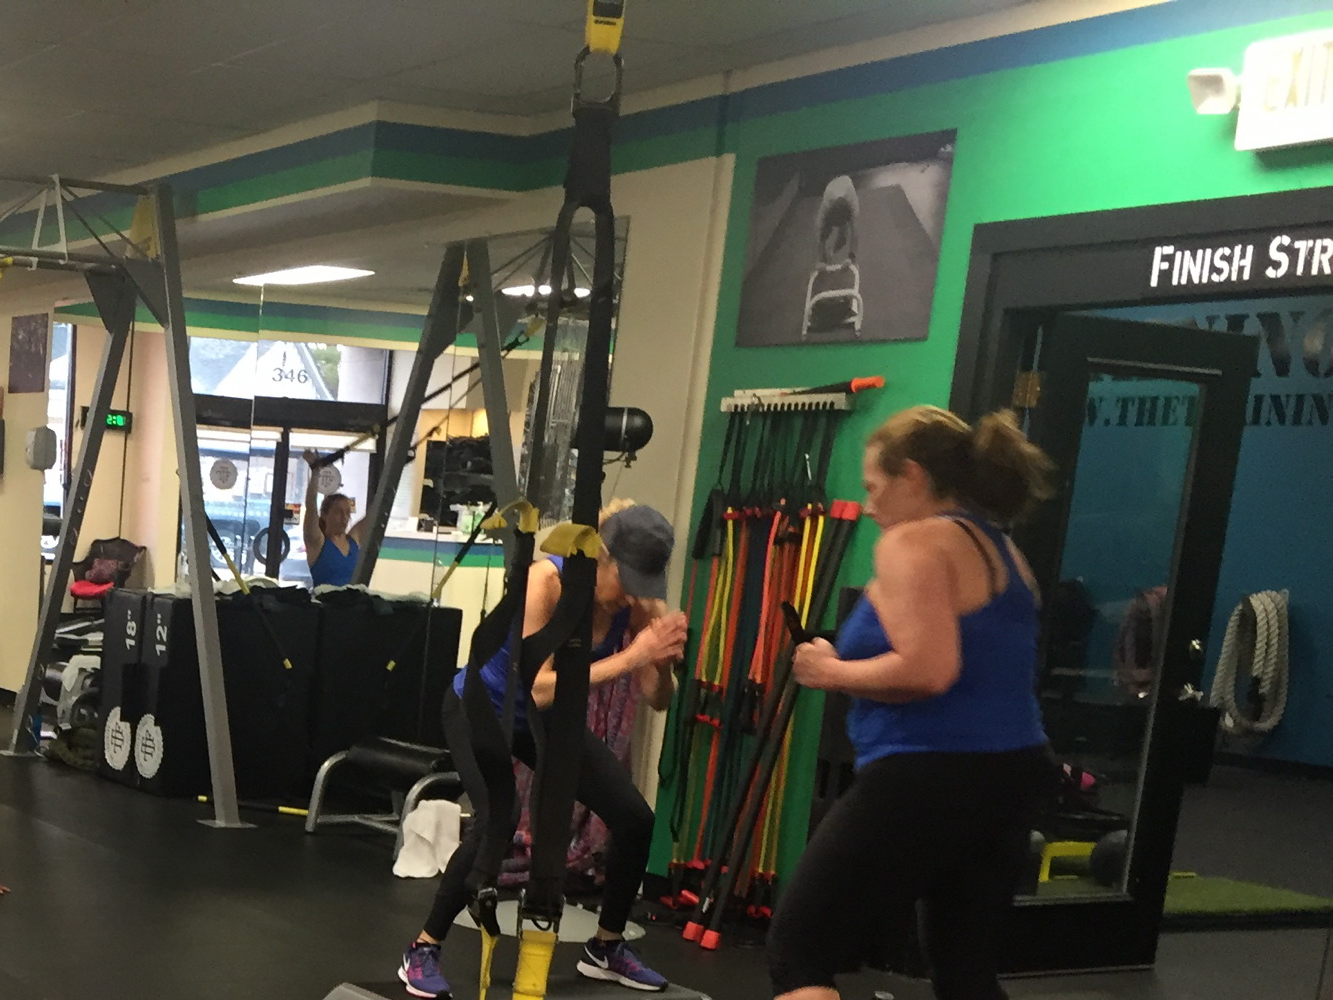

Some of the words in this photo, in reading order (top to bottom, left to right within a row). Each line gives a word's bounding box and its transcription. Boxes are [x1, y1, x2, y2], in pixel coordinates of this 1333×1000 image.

[1150, 244, 1254, 287] FINISH
[1265, 234, 1333, 279] STR
[272, 367, 308, 384] 346
